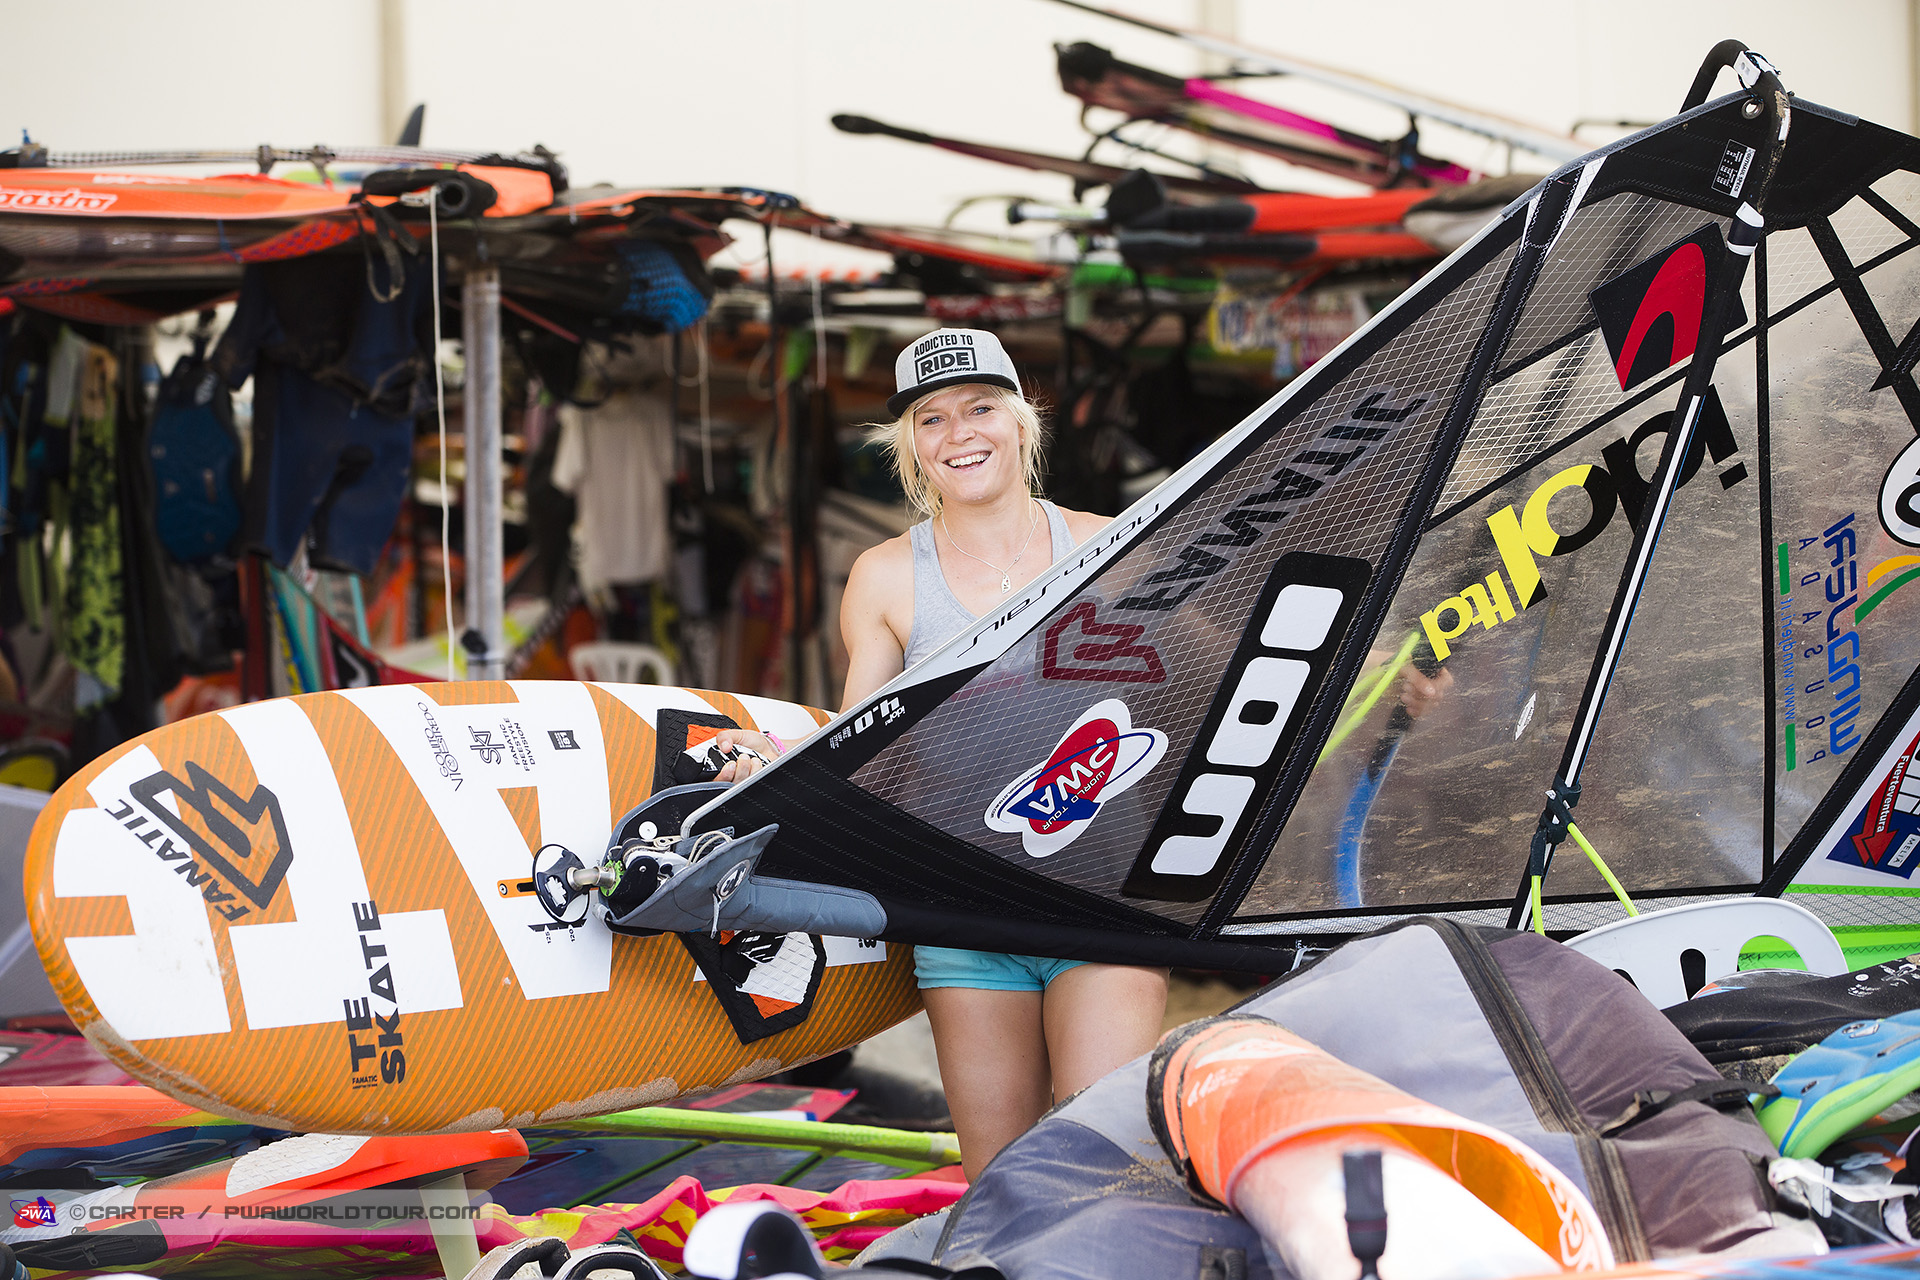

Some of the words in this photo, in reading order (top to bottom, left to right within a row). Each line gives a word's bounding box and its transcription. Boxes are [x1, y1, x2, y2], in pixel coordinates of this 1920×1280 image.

[914, 334, 957, 358] ADDICTED
[960, 334, 974, 346] TO
[920, 352, 970, 376] RIDE
[1484, 384, 1748, 613] idol
[1063, 502, 1161, 577] north
[1419, 570, 1516, 661] ltd
[499, 723, 520, 765] FANATIC
[854, 696, 900, 735] 4.0
[1028, 736, 1114, 815] PWA
[1070, 771, 1106, 804] WORLD
[1876, 754, 1910, 834] Fuerteventura
[1043, 805, 1069, 831] TOUR
[104, 797, 250, 922] FANATIC
[352, 900, 406, 1085] SKATE
[343, 997, 376, 1073] TE
